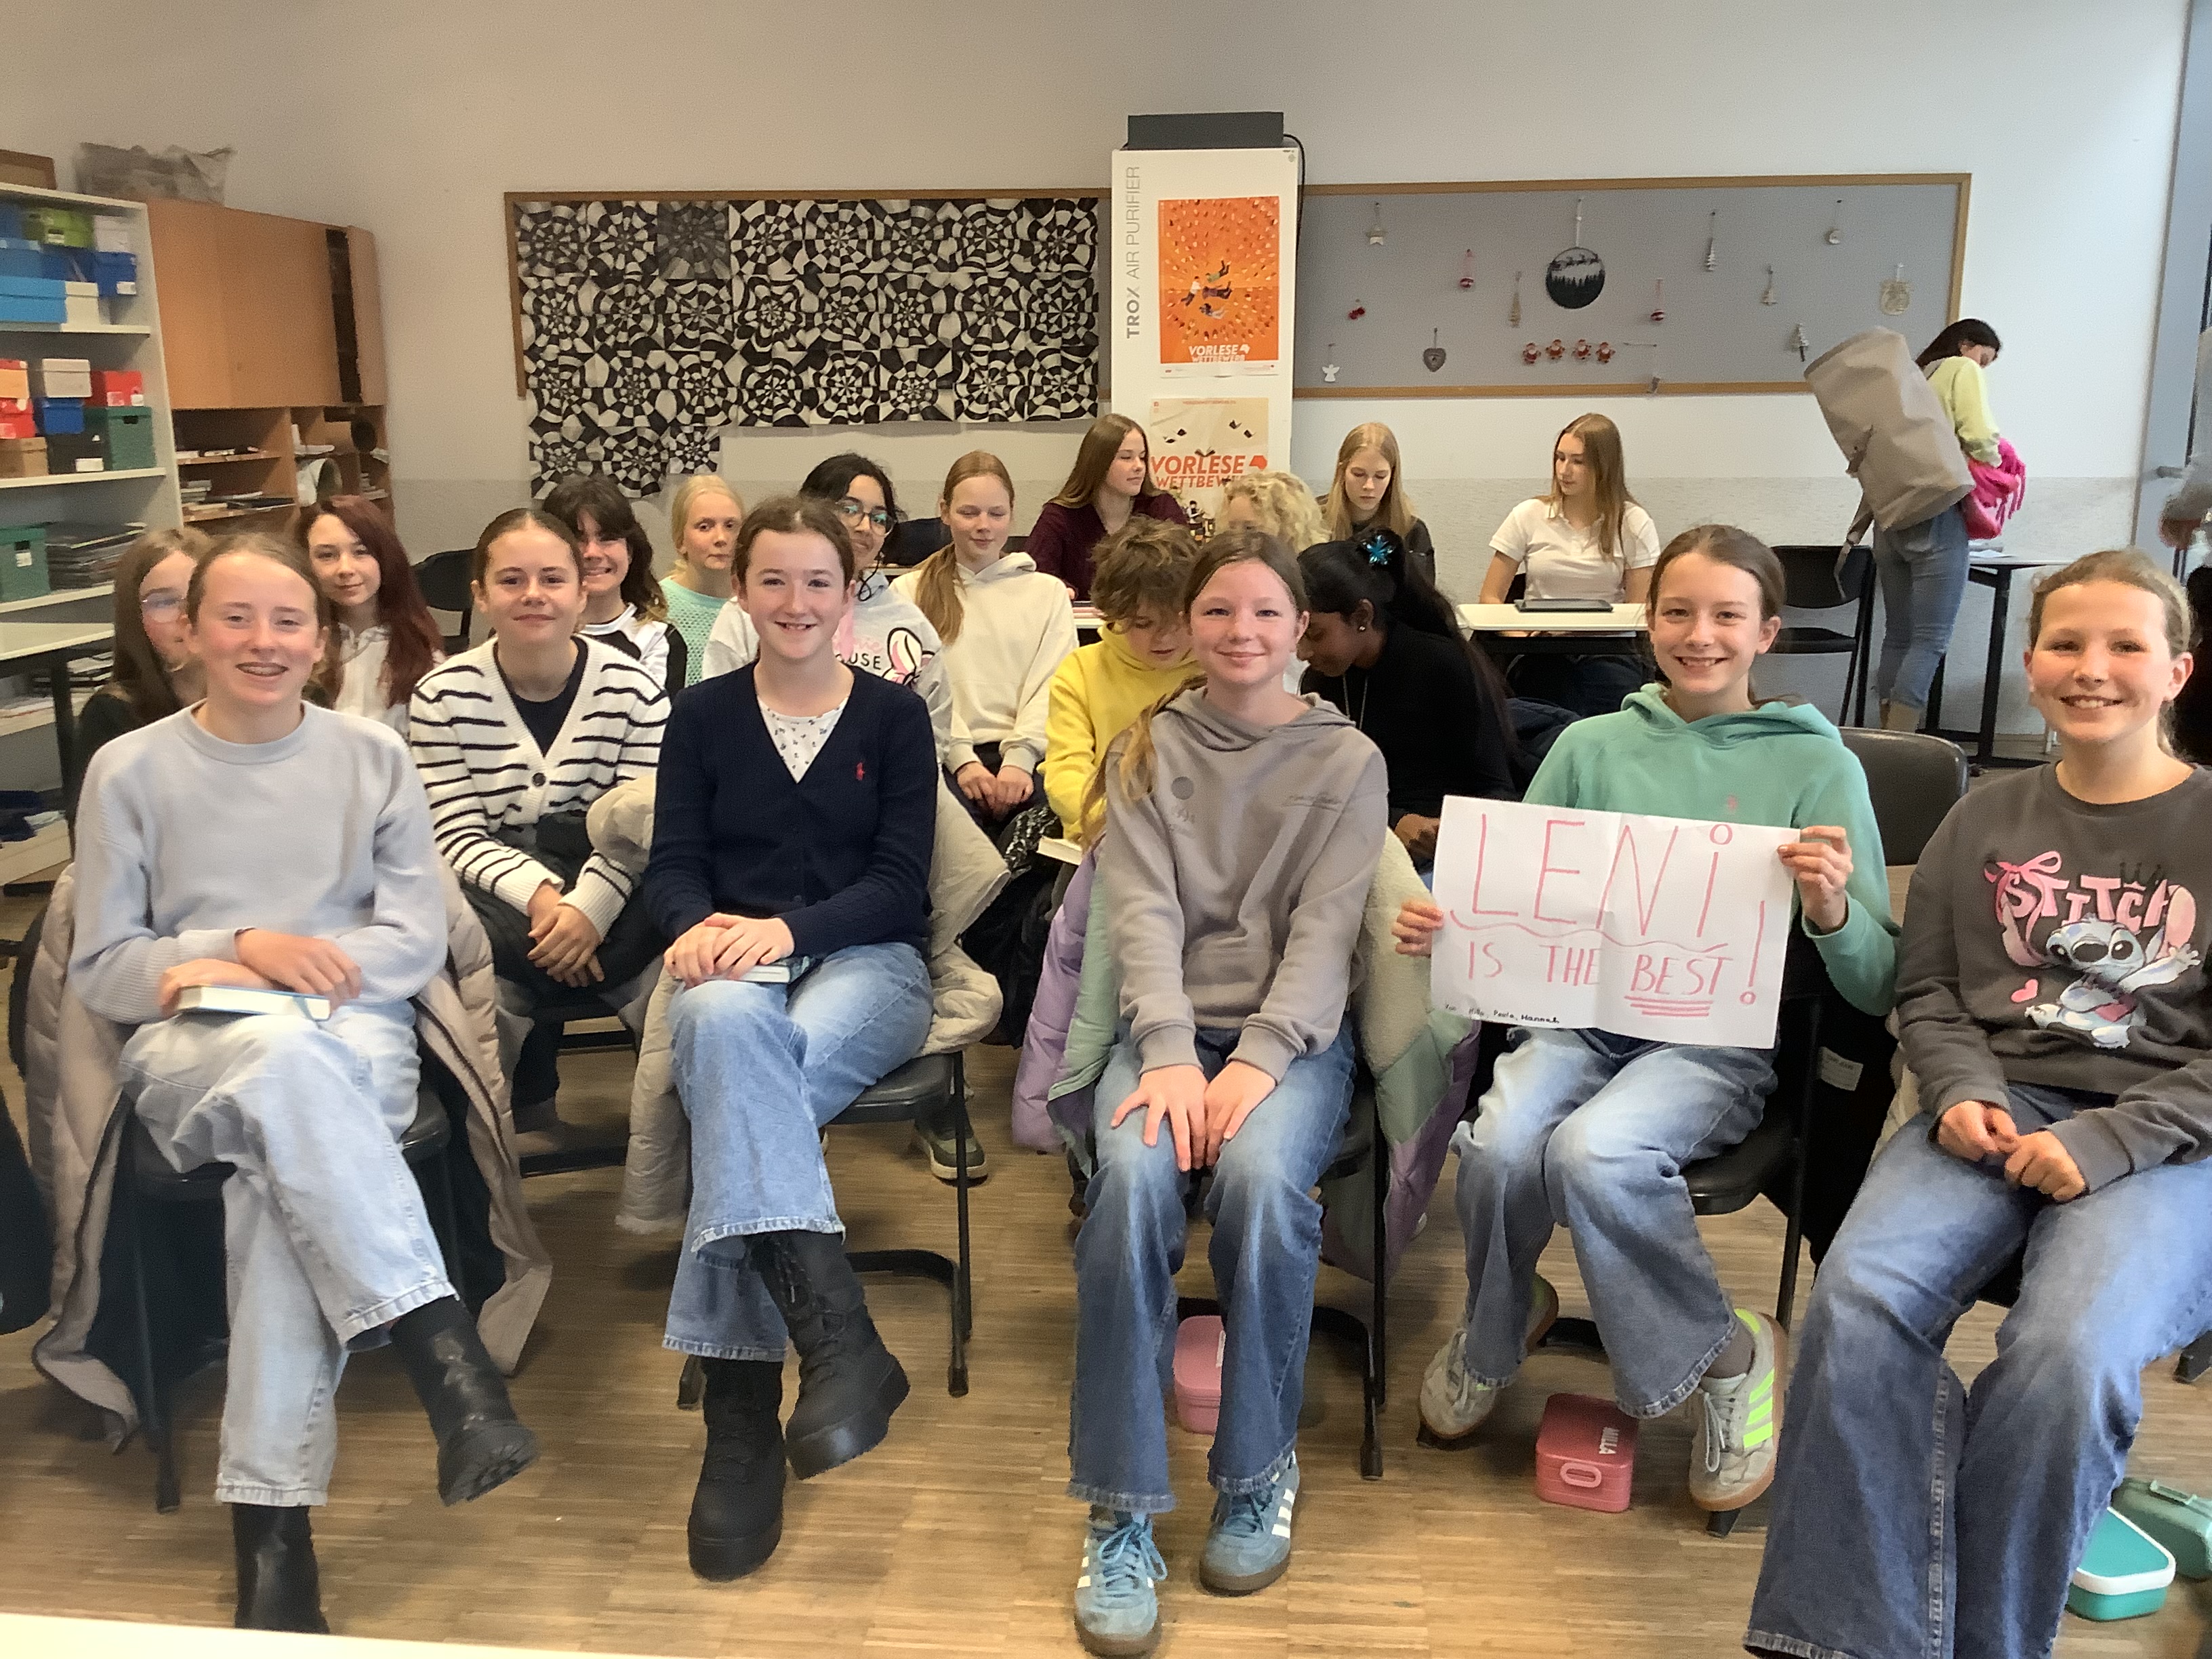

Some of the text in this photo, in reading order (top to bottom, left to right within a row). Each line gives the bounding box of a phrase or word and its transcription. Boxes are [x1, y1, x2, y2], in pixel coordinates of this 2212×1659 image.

[1126, 167, 1141, 339] TROX AIR PURIFIER
[1189, 344, 1239, 356] VORLESE
[1151, 455, 1246, 474] VORLESE
[1468, 941, 1503, 980] IS
[1539, 945, 1600, 987] THE
